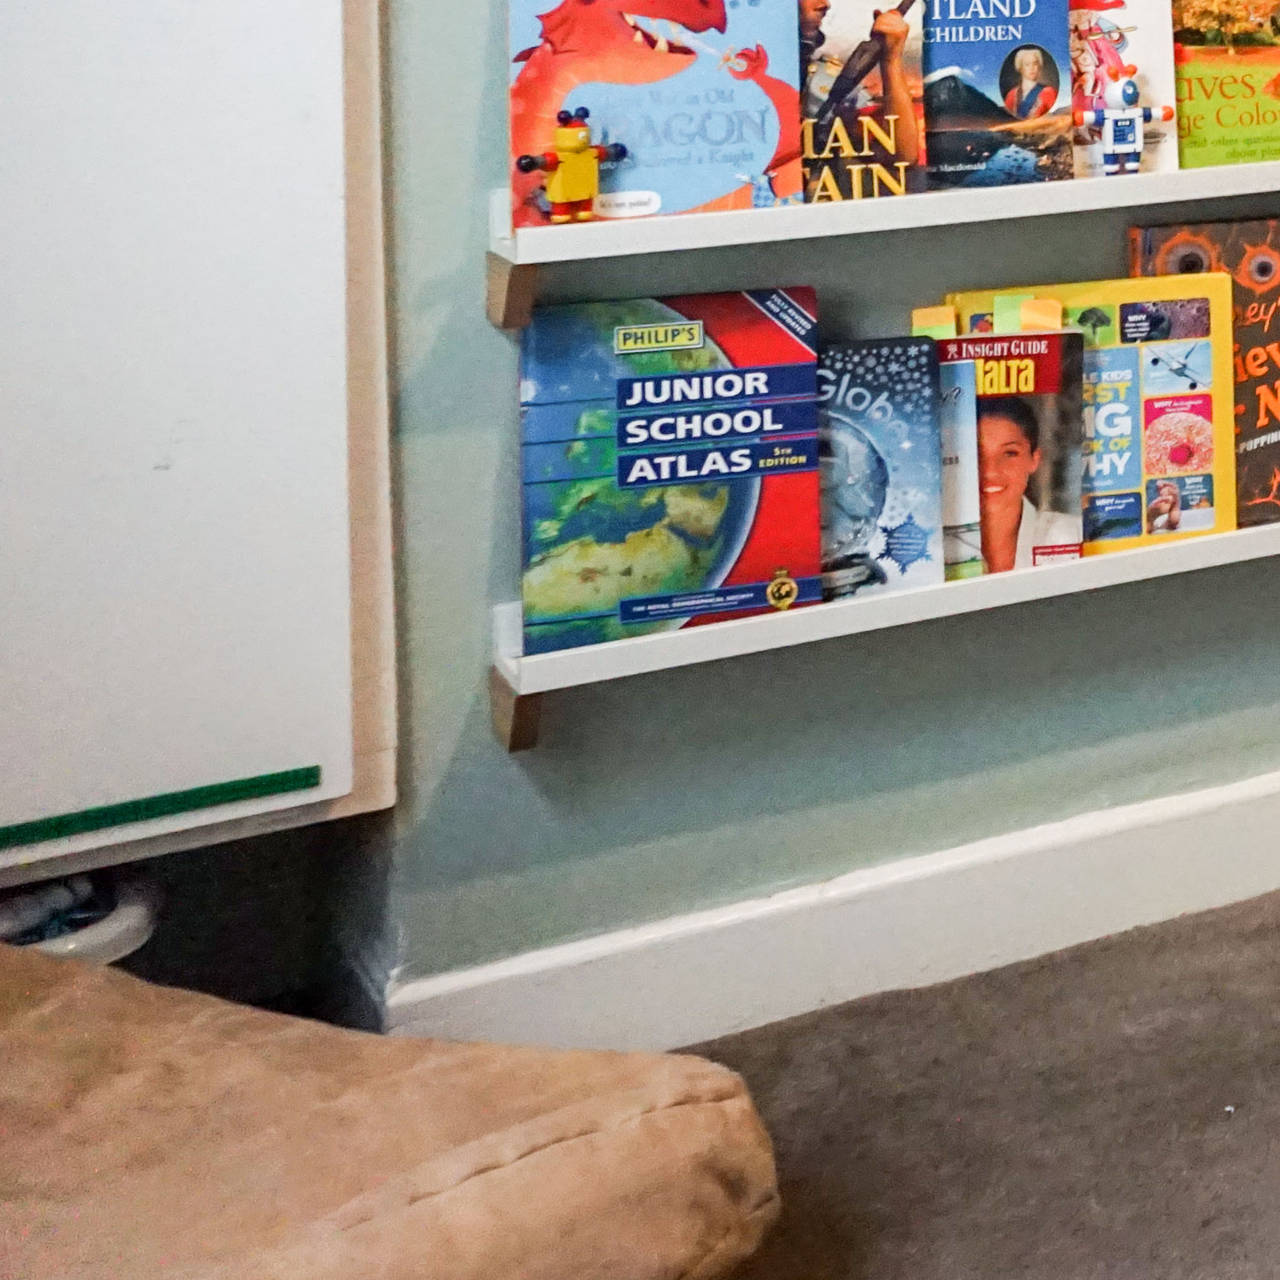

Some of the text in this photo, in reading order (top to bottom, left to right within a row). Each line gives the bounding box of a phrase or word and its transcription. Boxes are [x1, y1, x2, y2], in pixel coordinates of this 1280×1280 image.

[922, 24, 1023, 43] CHILDREN
[802, 161, 911, 205] AIN
[622, 326, 696, 347] PHILIP'S
[961, 339, 1049, 359] INSIGHT GUIDE
[1101, 369, 1133, 382] KIDS
[626, 372, 770, 407] JUNIOR
[626, 409, 784, 444] SCHOOL
[1109, 437, 1132, 452] OF
[626, 448, 753, 484] ATLAS
[758, 454, 807, 469] EDITION
